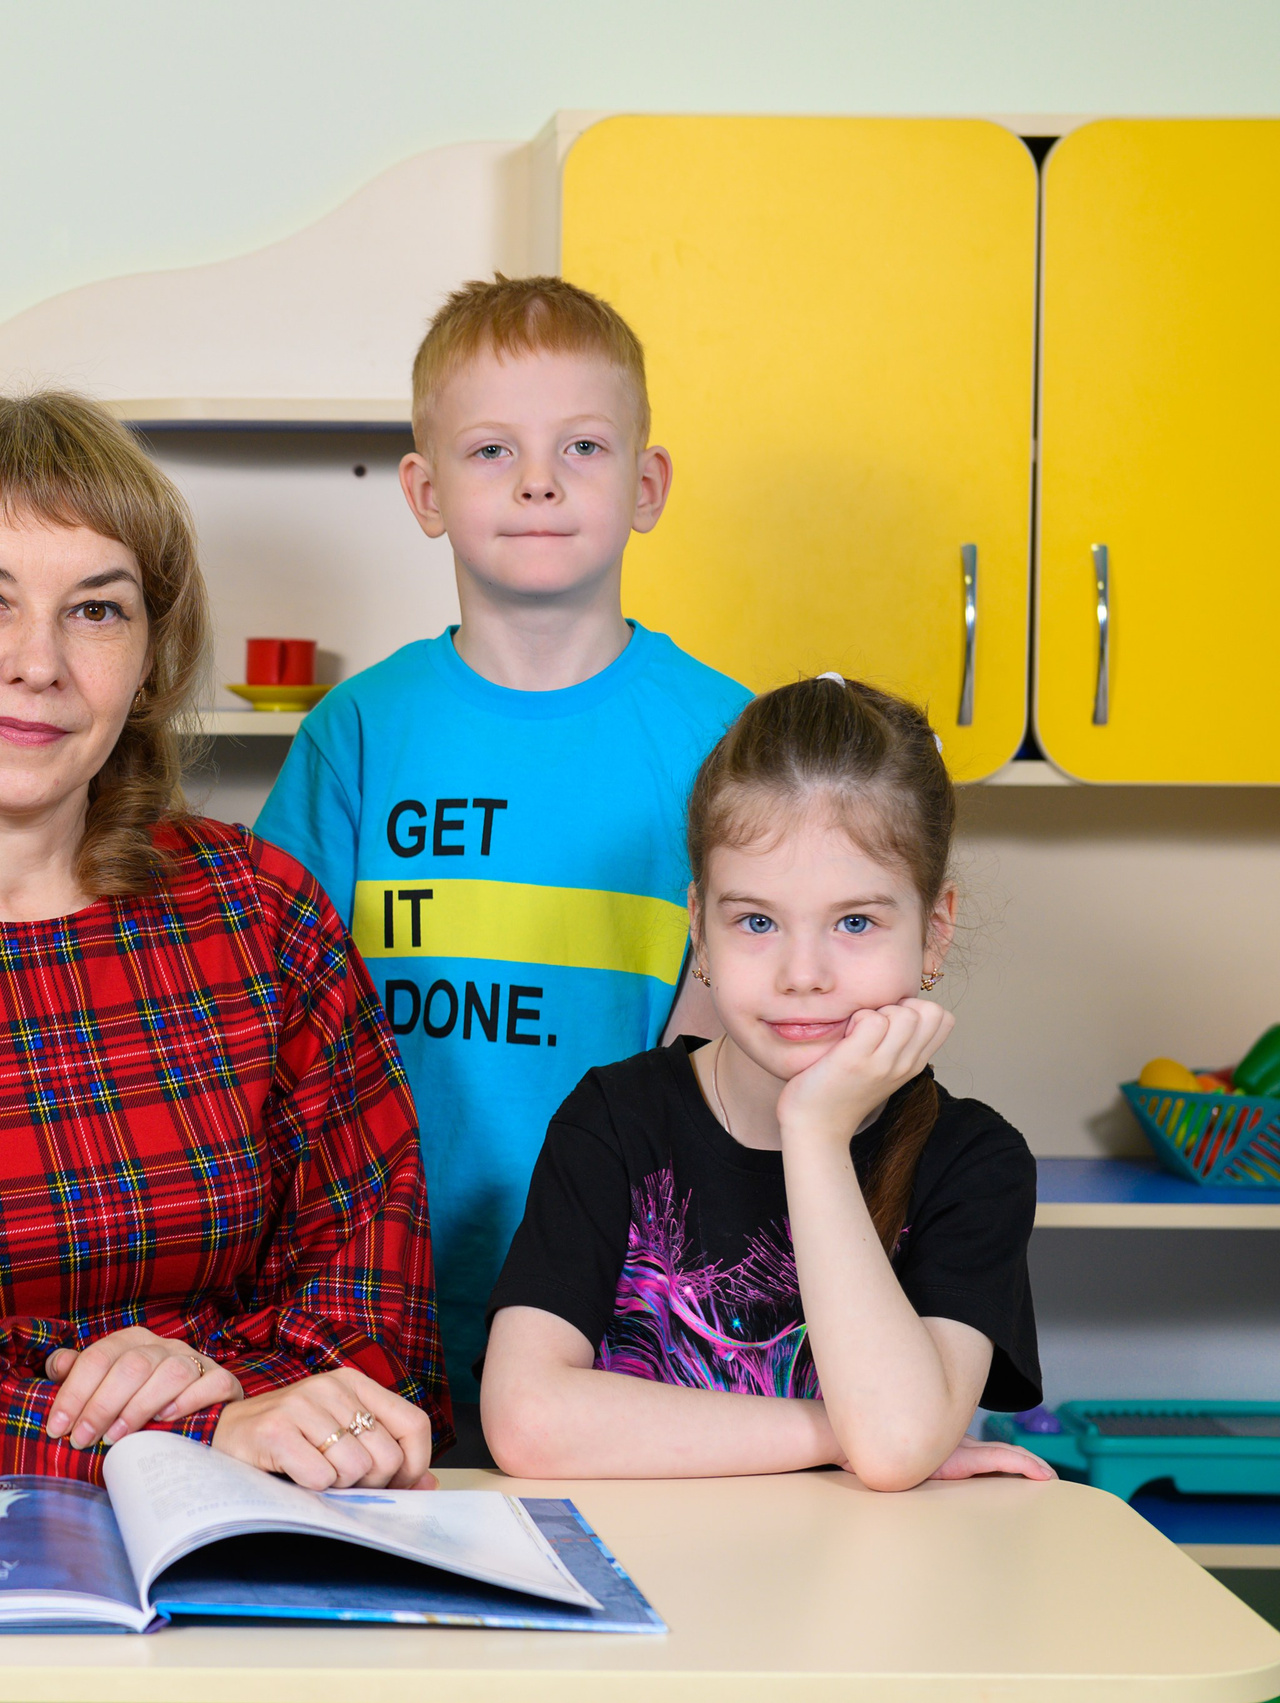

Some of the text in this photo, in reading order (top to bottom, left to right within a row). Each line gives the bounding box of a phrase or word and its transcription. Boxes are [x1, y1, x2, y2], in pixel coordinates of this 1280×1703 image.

[386, 798, 508, 858] GET
[383, 889, 434, 949] IT
[384, 979, 557, 1047] DONE.
